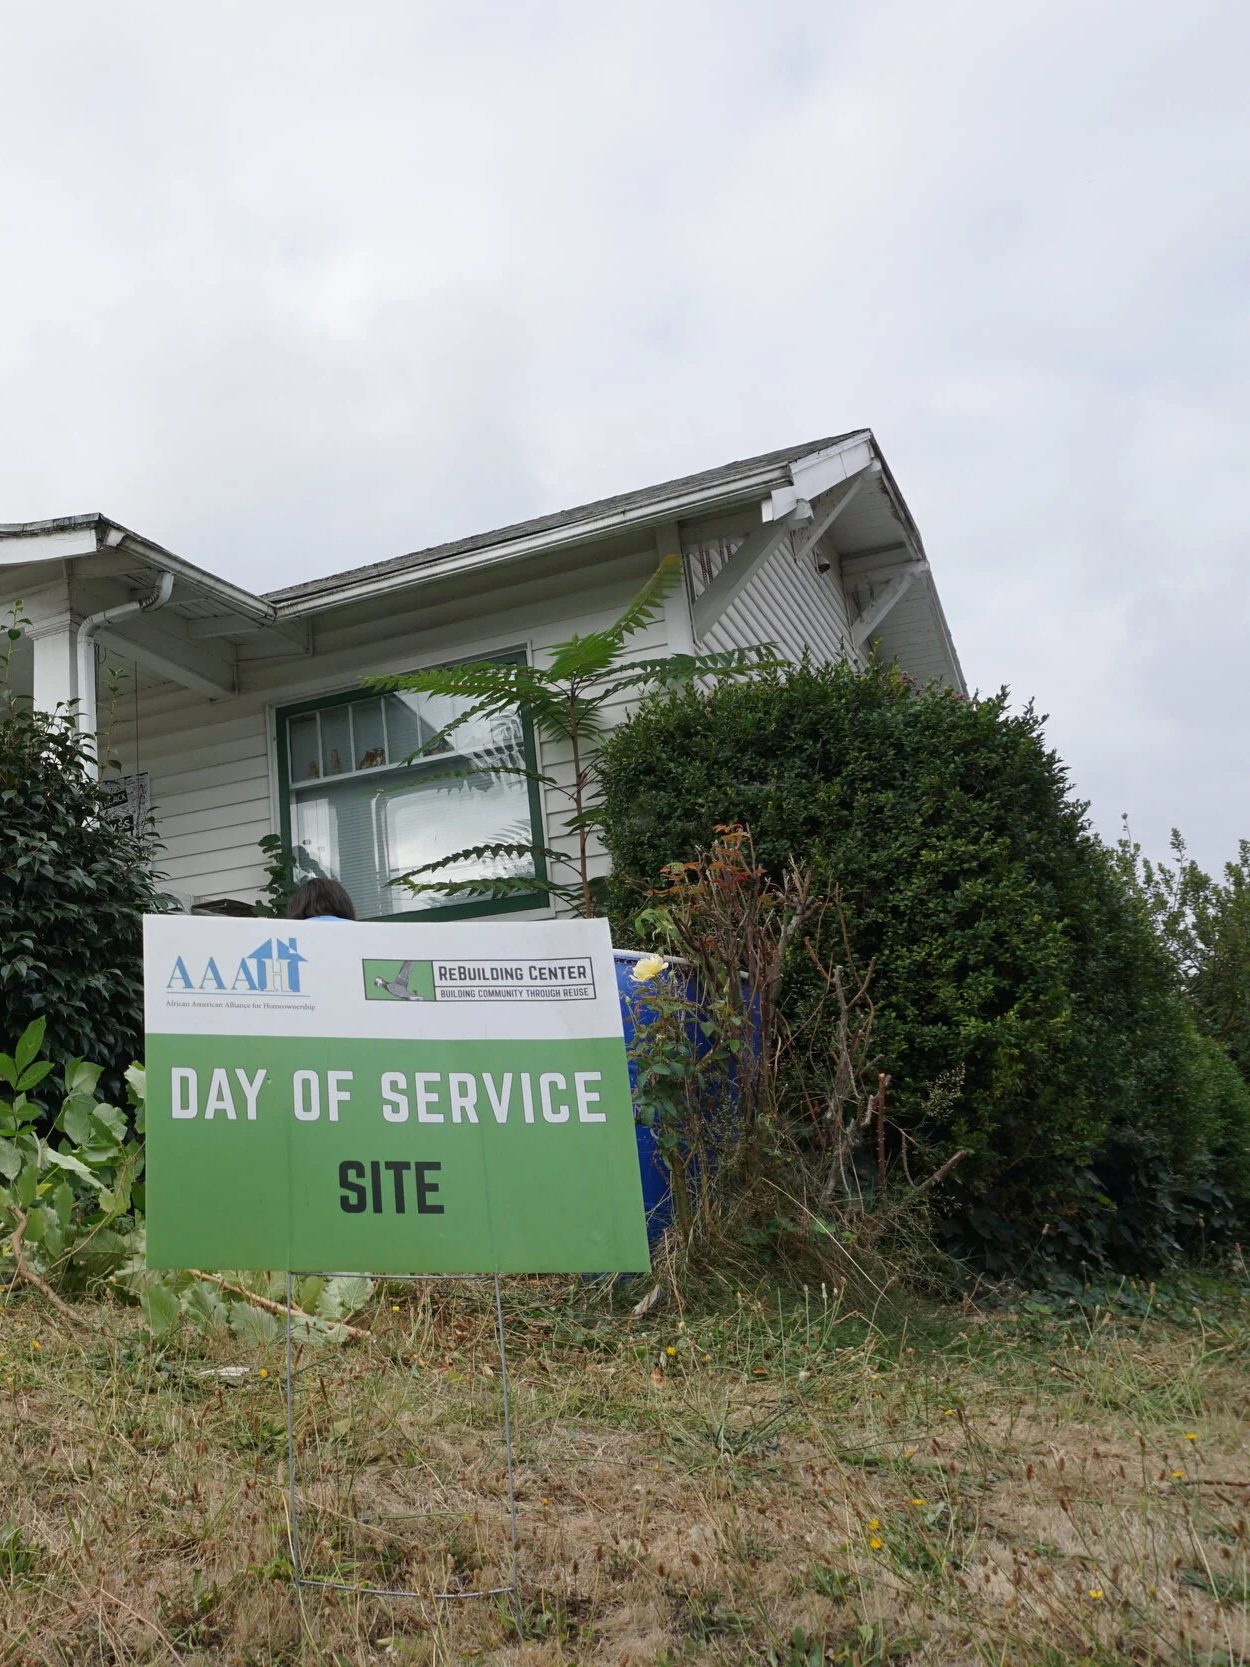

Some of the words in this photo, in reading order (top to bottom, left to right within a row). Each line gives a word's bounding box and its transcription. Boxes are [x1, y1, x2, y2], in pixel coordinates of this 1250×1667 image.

[166, 953, 297, 993] AAAH
[438, 966, 524, 981] REBUILDING
[529, 965, 587, 980] CENTER
[166, 1000, 190, 1008] African
[191, 1001, 223, 1009] American
[224, 1001, 251, 1009] Alliance
[263, 1002, 316, 1012] Homeownership
[440, 989, 476, 998] BUILDING
[478, 989, 523, 998] COMMUNITY
[525, 988, 561, 998] THROUGH
[563, 987, 589, 997] REUSE
[171, 1067, 267, 1120] DAY
[292, 1069, 354, 1122] OF
[380, 1071, 607, 1124] SERVICE
[338, 1160, 445, 1214] SITE
